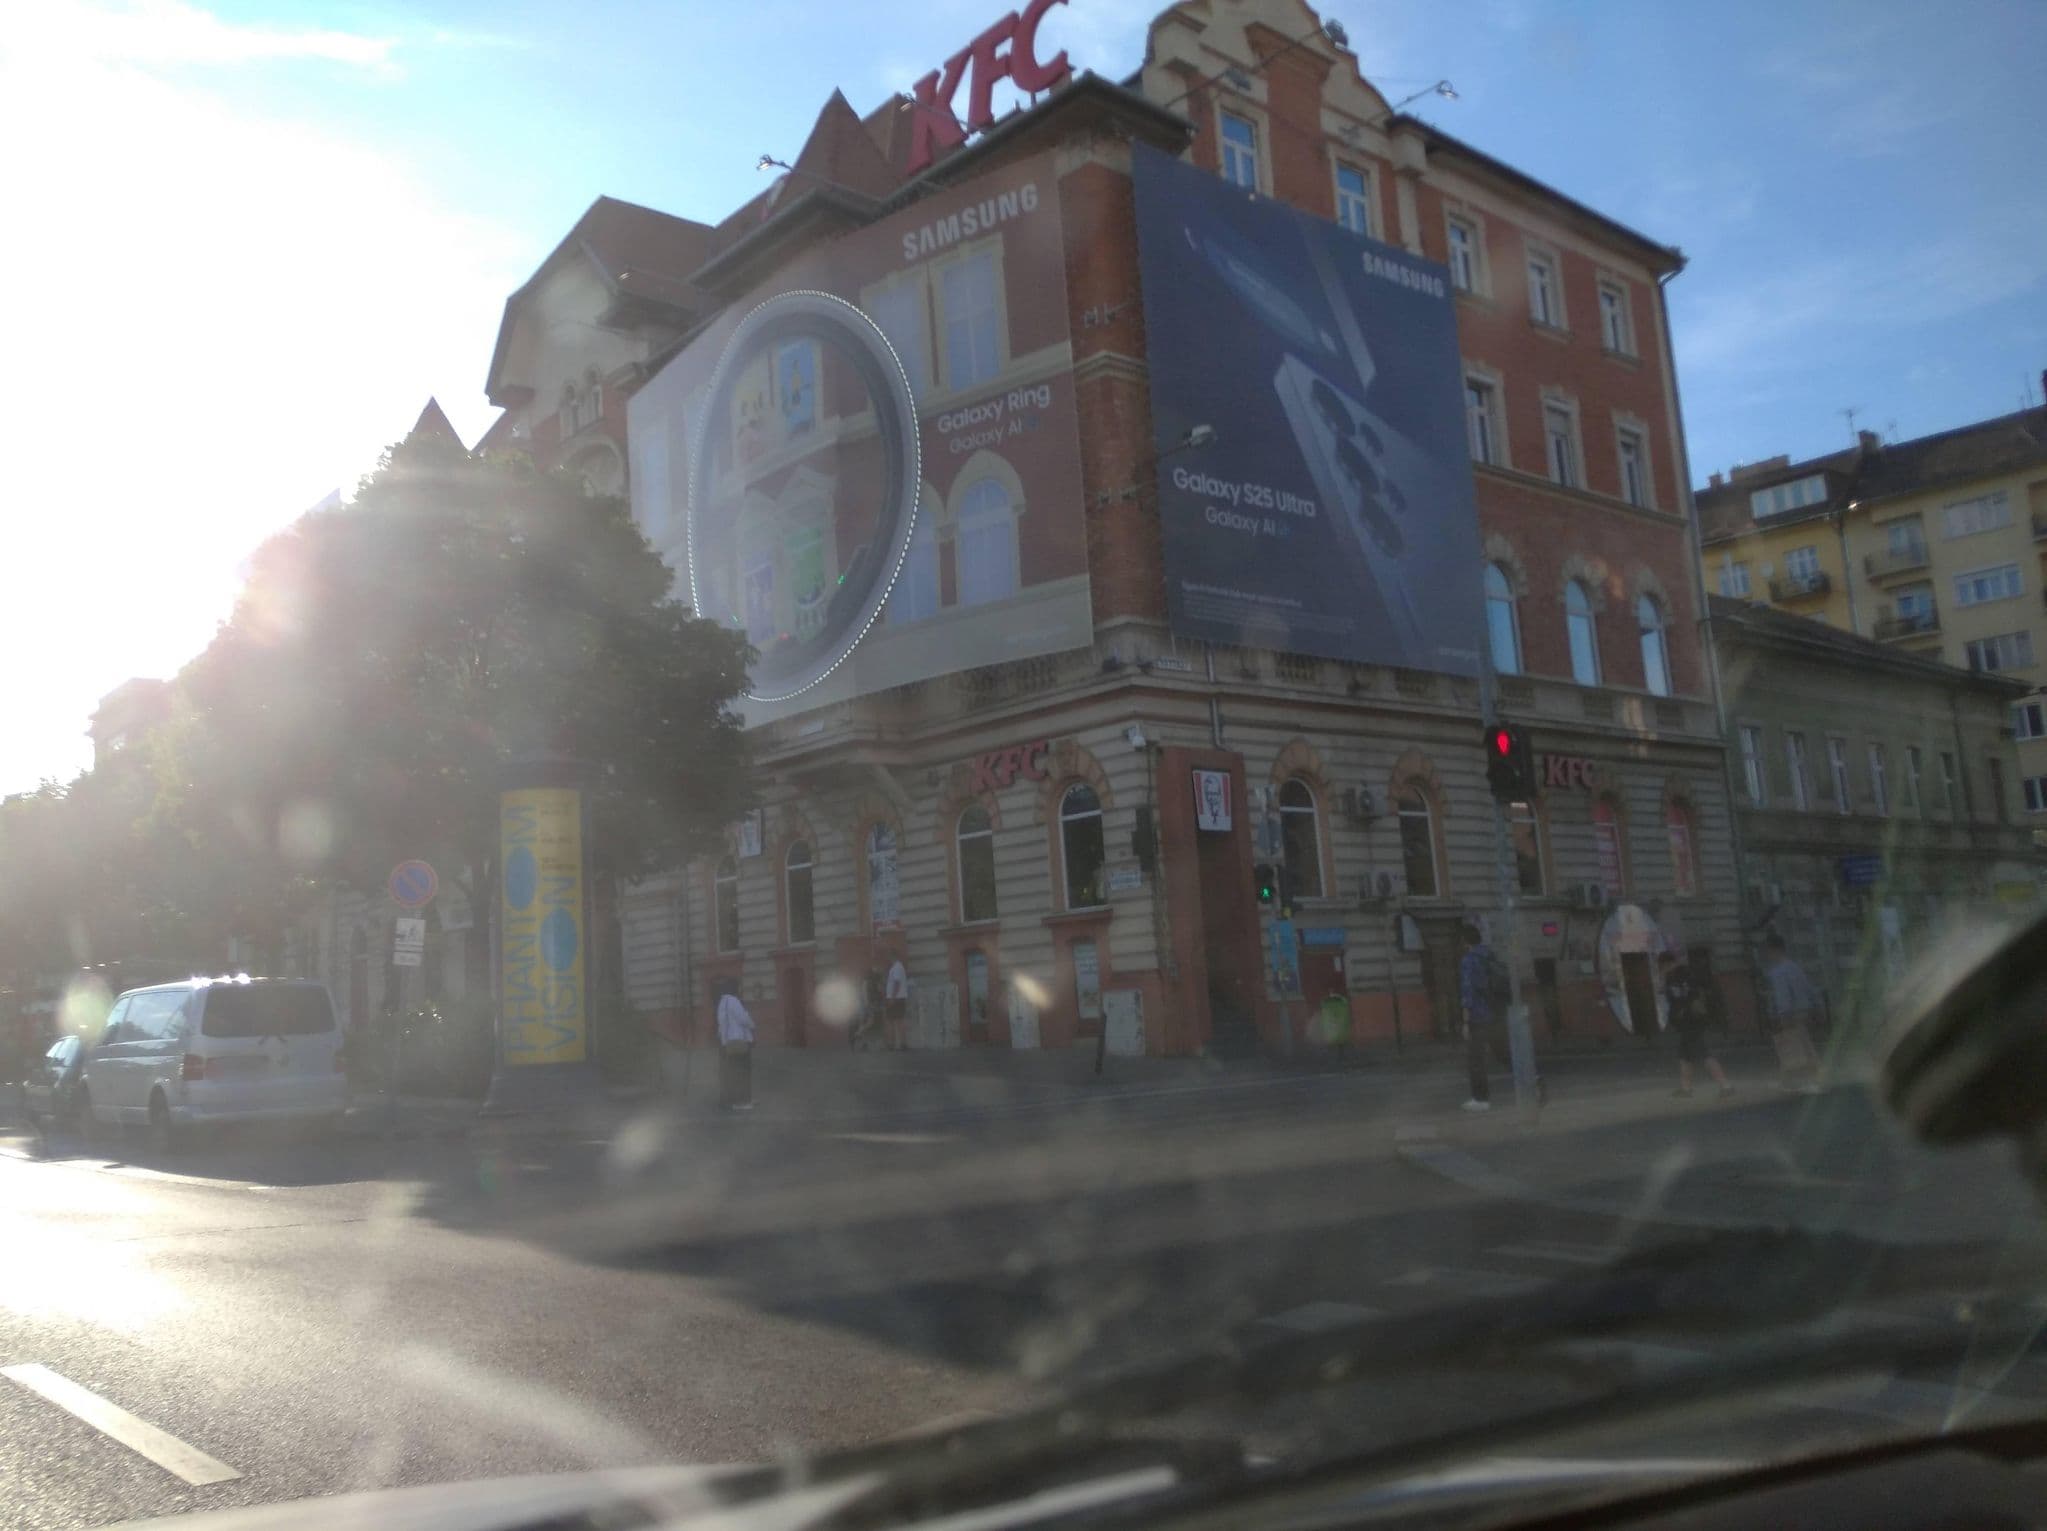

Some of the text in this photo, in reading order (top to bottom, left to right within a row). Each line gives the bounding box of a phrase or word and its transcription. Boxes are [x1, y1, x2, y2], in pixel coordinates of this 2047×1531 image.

[906, 0, 1068, 174] KFC
[903, 184, 1038, 261] SAMSUNG
[1362, 252, 1445, 298] SAMSUNG
[937, 384, 1051, 433] Galaxy Ring
[950, 417, 1023, 453] Galaxy AI
[1173, 467, 1316, 517] Galaxy S25 Ultra
[1205, 506, 1276, 537] Galaxy AI
[971, 739, 1050, 795] KFC
[1544, 753, 1595, 787] KFC
